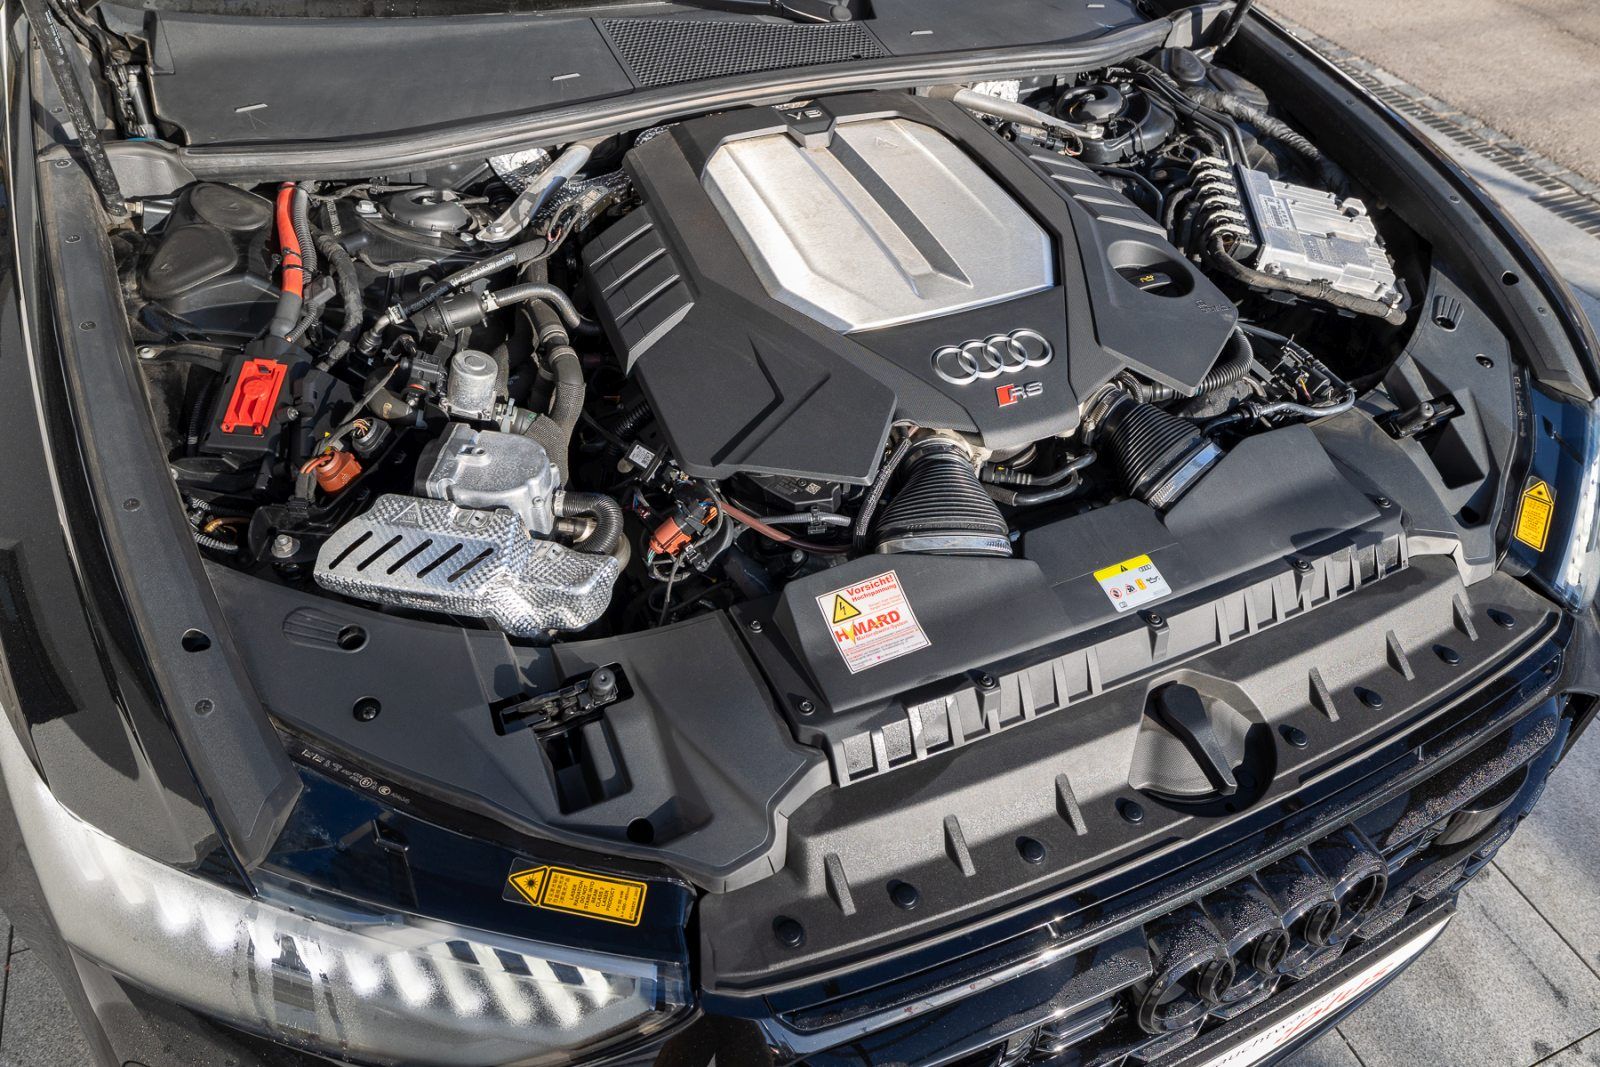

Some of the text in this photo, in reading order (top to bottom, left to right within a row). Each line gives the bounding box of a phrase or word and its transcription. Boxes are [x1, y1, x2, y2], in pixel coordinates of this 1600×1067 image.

[1008, 381, 1044, 401] RS
[846, 574, 895, 597] Vorsicht!
[851, 583, 897, 603] Hochspannung
[573, 880, 584, 906] RADIATION
[580, 895, 586, 904] DO
[583, 893, 591, 909] STARE
[596, 891, 604, 907] CLASS
[606, 887, 615, 911] PRODUCT
